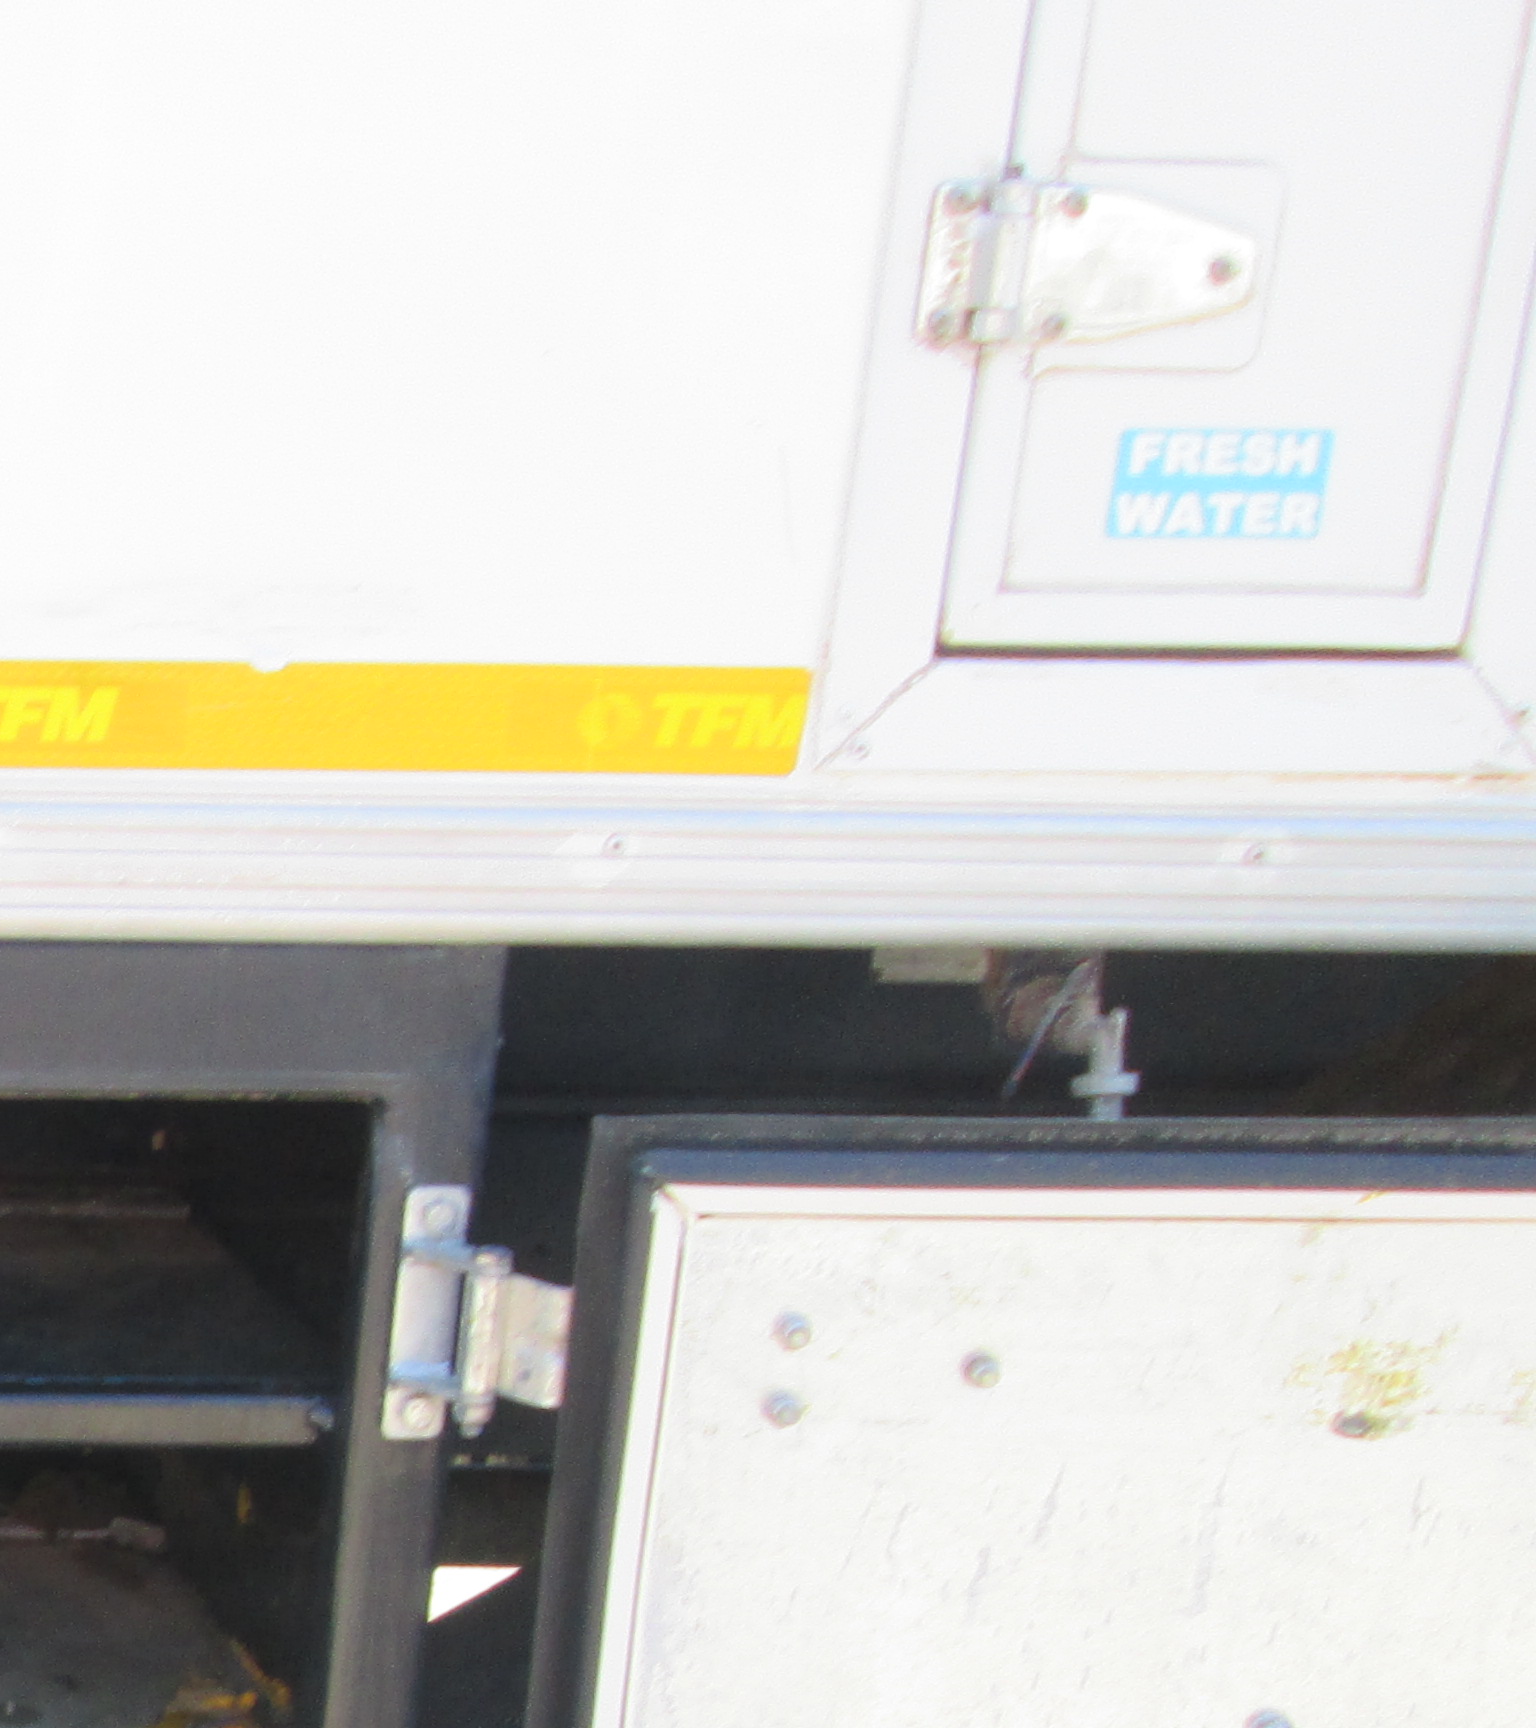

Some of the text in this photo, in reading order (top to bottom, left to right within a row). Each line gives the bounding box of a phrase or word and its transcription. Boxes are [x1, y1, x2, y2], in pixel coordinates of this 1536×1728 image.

[1128, 432, 1322, 476] FRESH
[1115, 491, 1319, 534] WATER
[652, 692, 808, 748] TFM
